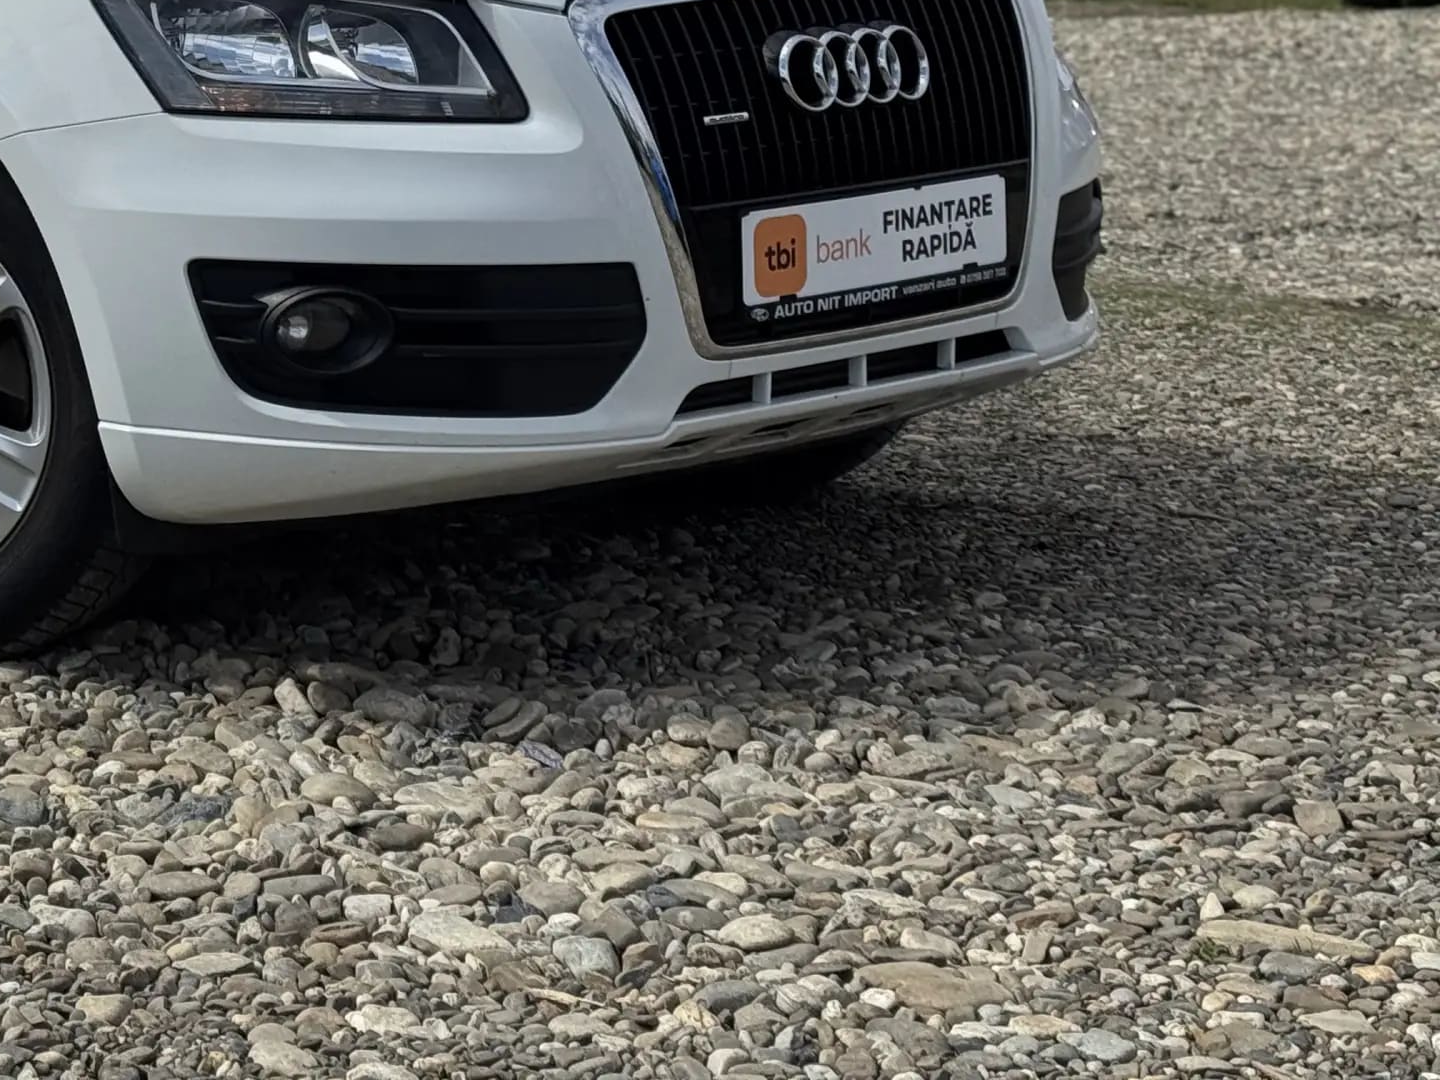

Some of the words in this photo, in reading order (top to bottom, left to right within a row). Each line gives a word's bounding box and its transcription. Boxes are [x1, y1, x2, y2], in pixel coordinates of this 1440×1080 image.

[882, 193, 993, 235] FINANȚARE
[764, 238, 797, 272] tbi
[816, 227, 872, 264] bank
[902, 221, 977, 263] RAPIDĂ
[774, 300, 814, 319] AUTO
[817, 295, 841, 312] NIT
[844, 286, 899, 308] IMPORT
